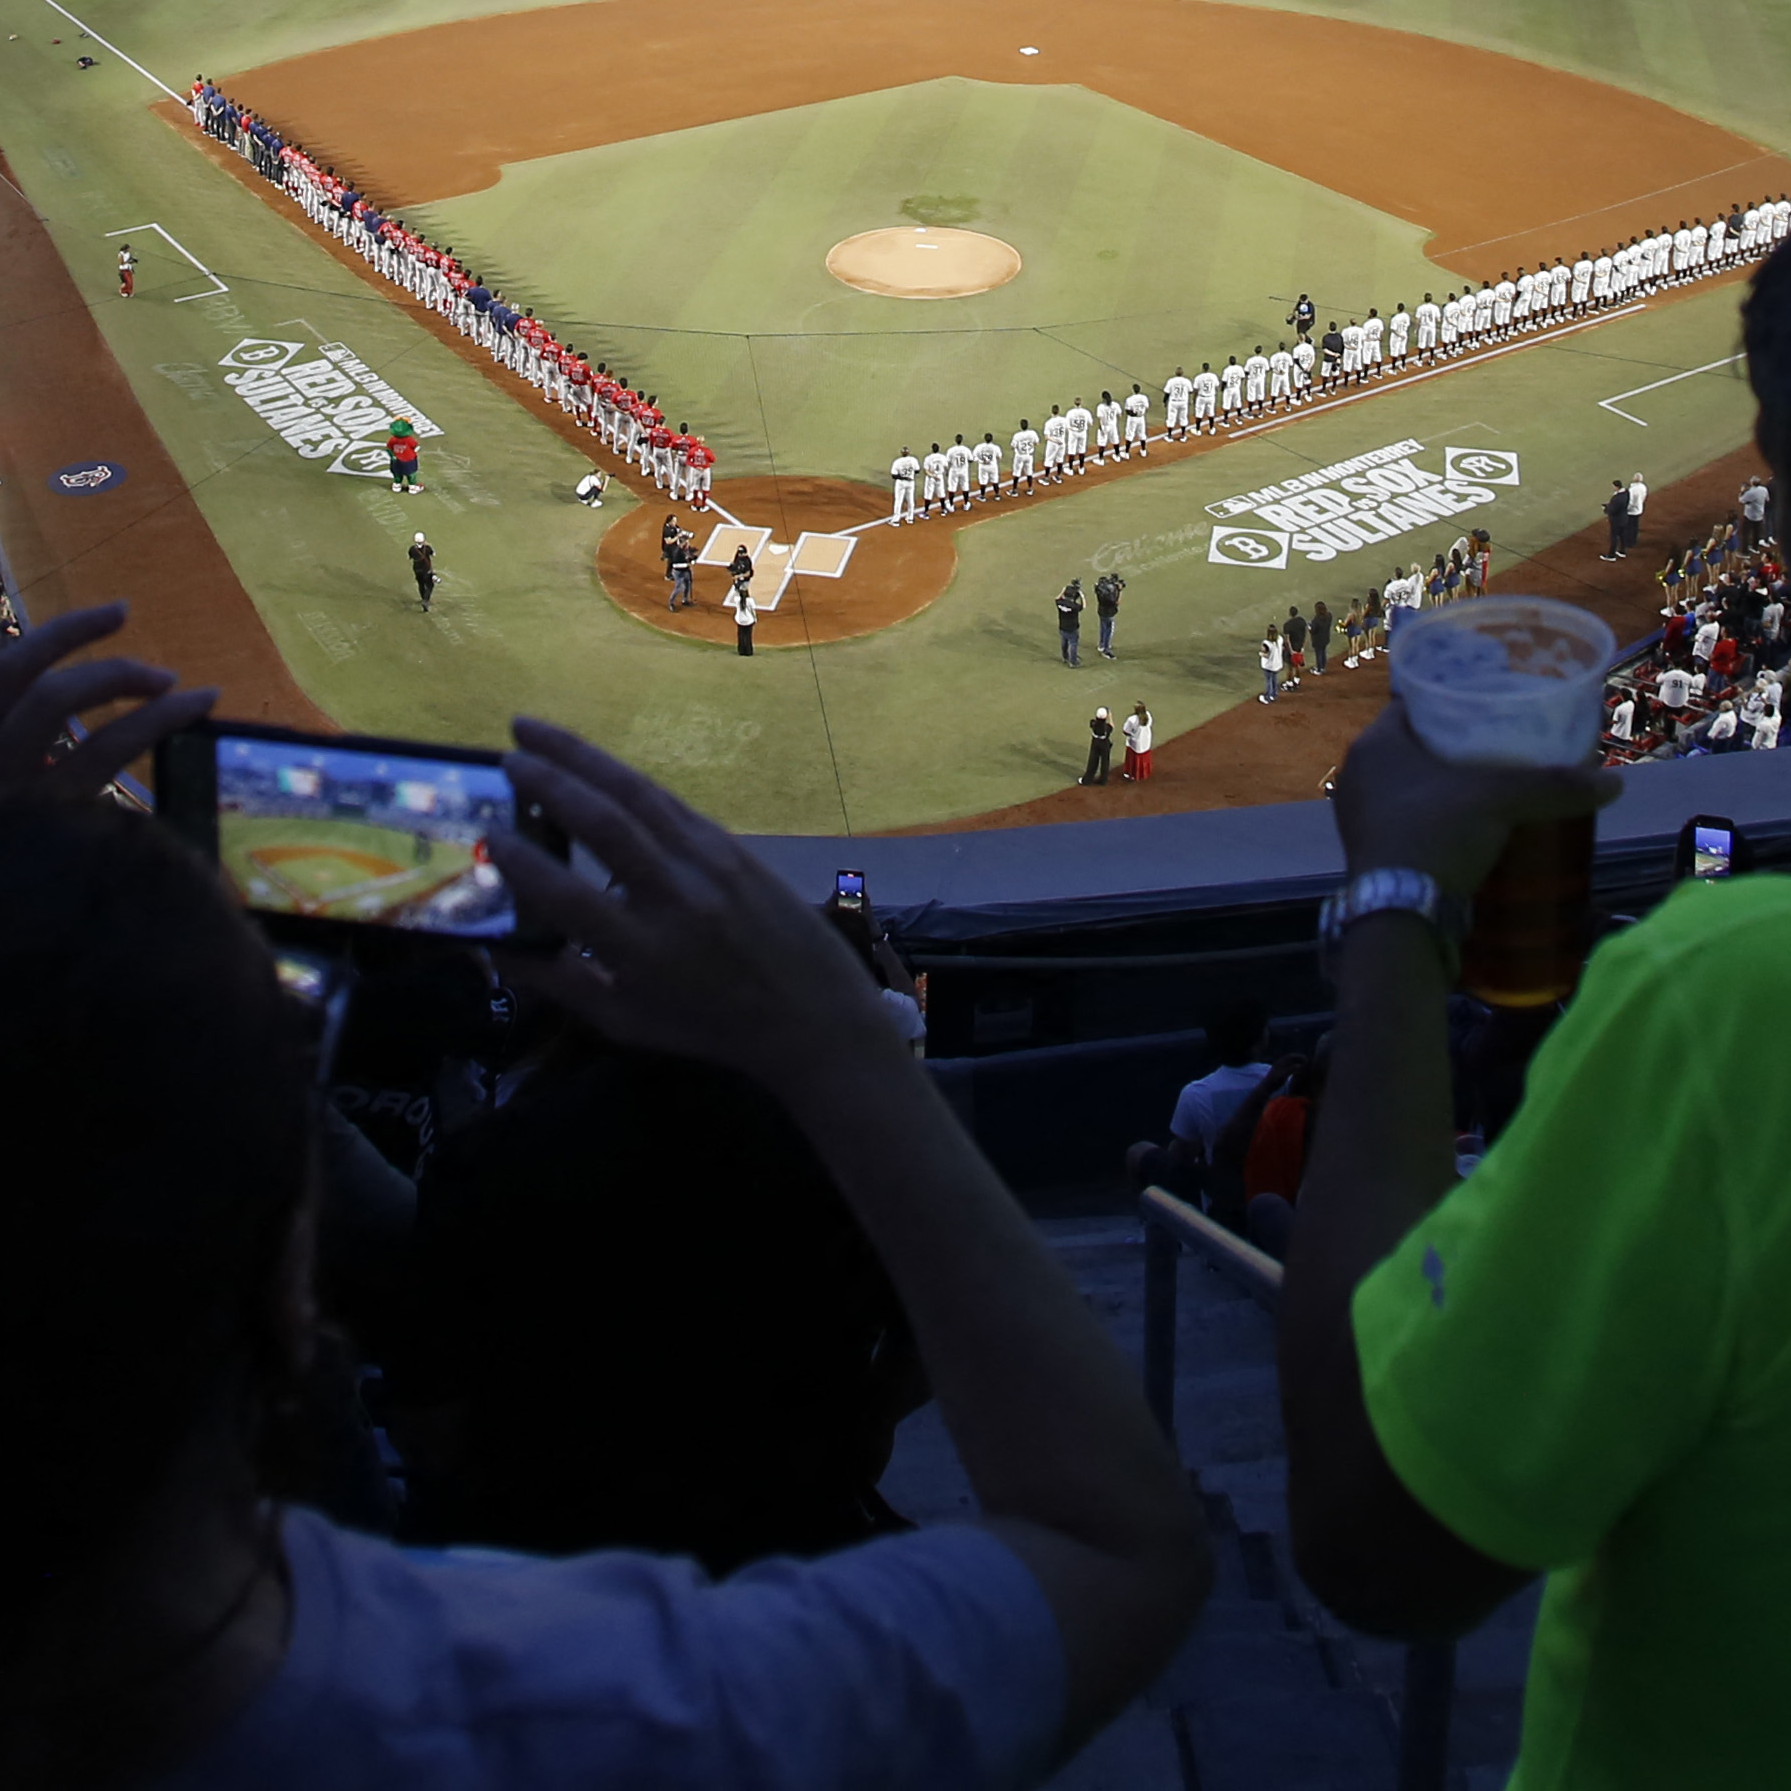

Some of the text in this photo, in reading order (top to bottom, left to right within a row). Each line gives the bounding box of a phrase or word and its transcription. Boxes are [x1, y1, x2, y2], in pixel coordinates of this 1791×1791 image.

[223, 368, 350, 459] SULTANES
[280, 358, 396, 440] RED SOX
[1247, 437, 1426, 506] MLB IN MONTERREY
[1253, 457, 1444, 533] RED SOX
[1290, 480, 1497, 562] SULTANES
